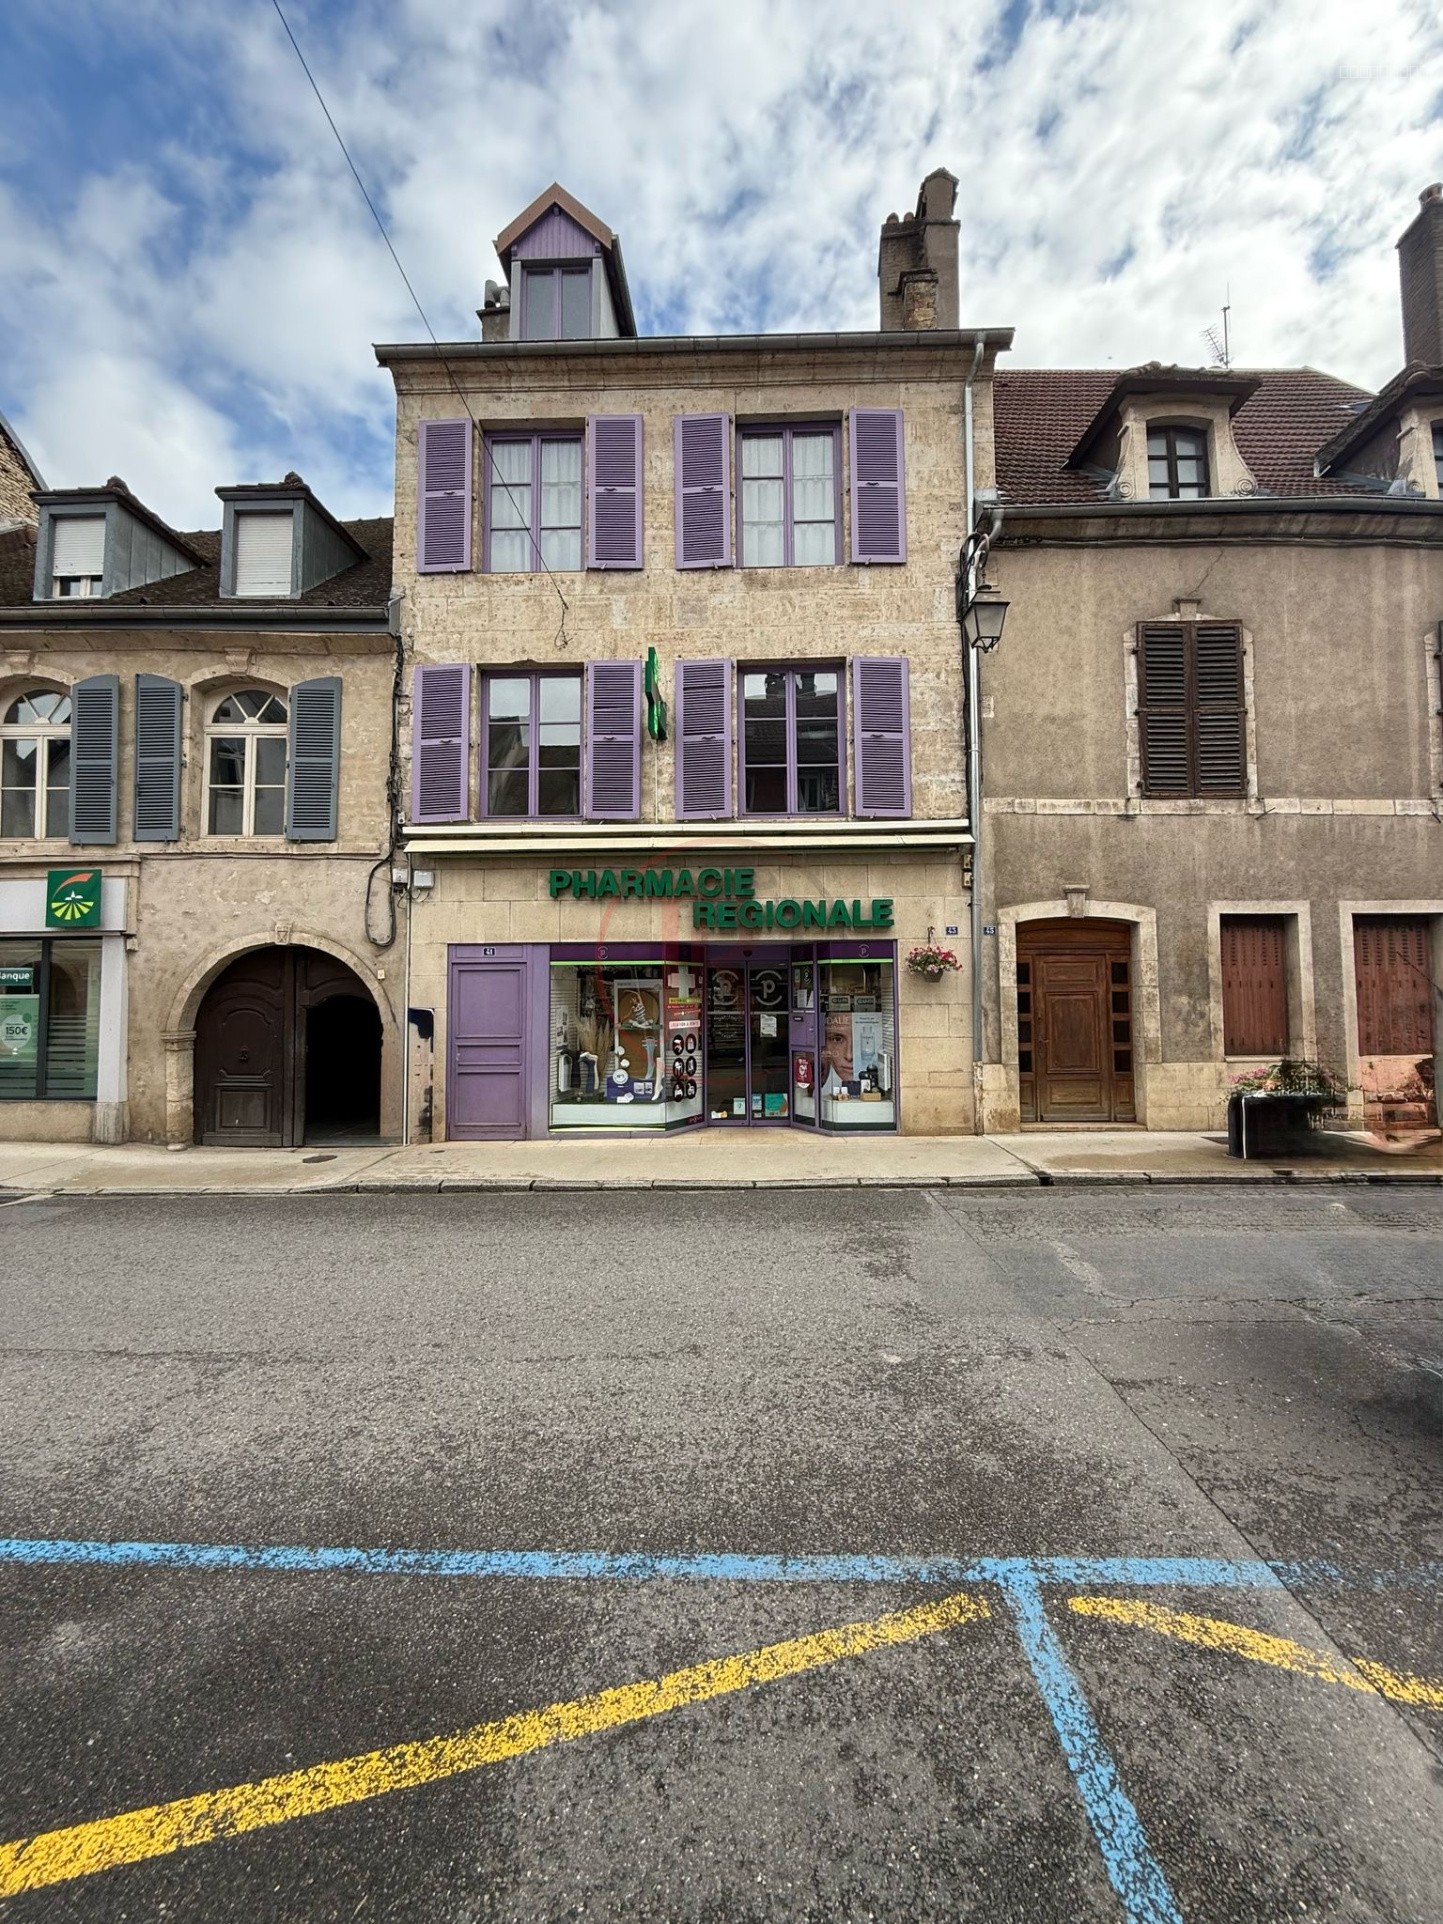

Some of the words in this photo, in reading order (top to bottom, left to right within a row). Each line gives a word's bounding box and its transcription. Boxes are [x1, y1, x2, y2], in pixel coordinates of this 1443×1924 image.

[549, 868, 755, 898] PHARMACIE
[693, 899, 895, 929] REGIONALE
[0, 972, 30, 982] anque
[826, 1015, 850, 1024] DALIE
[6, 1026, 28, 1035] 150€
